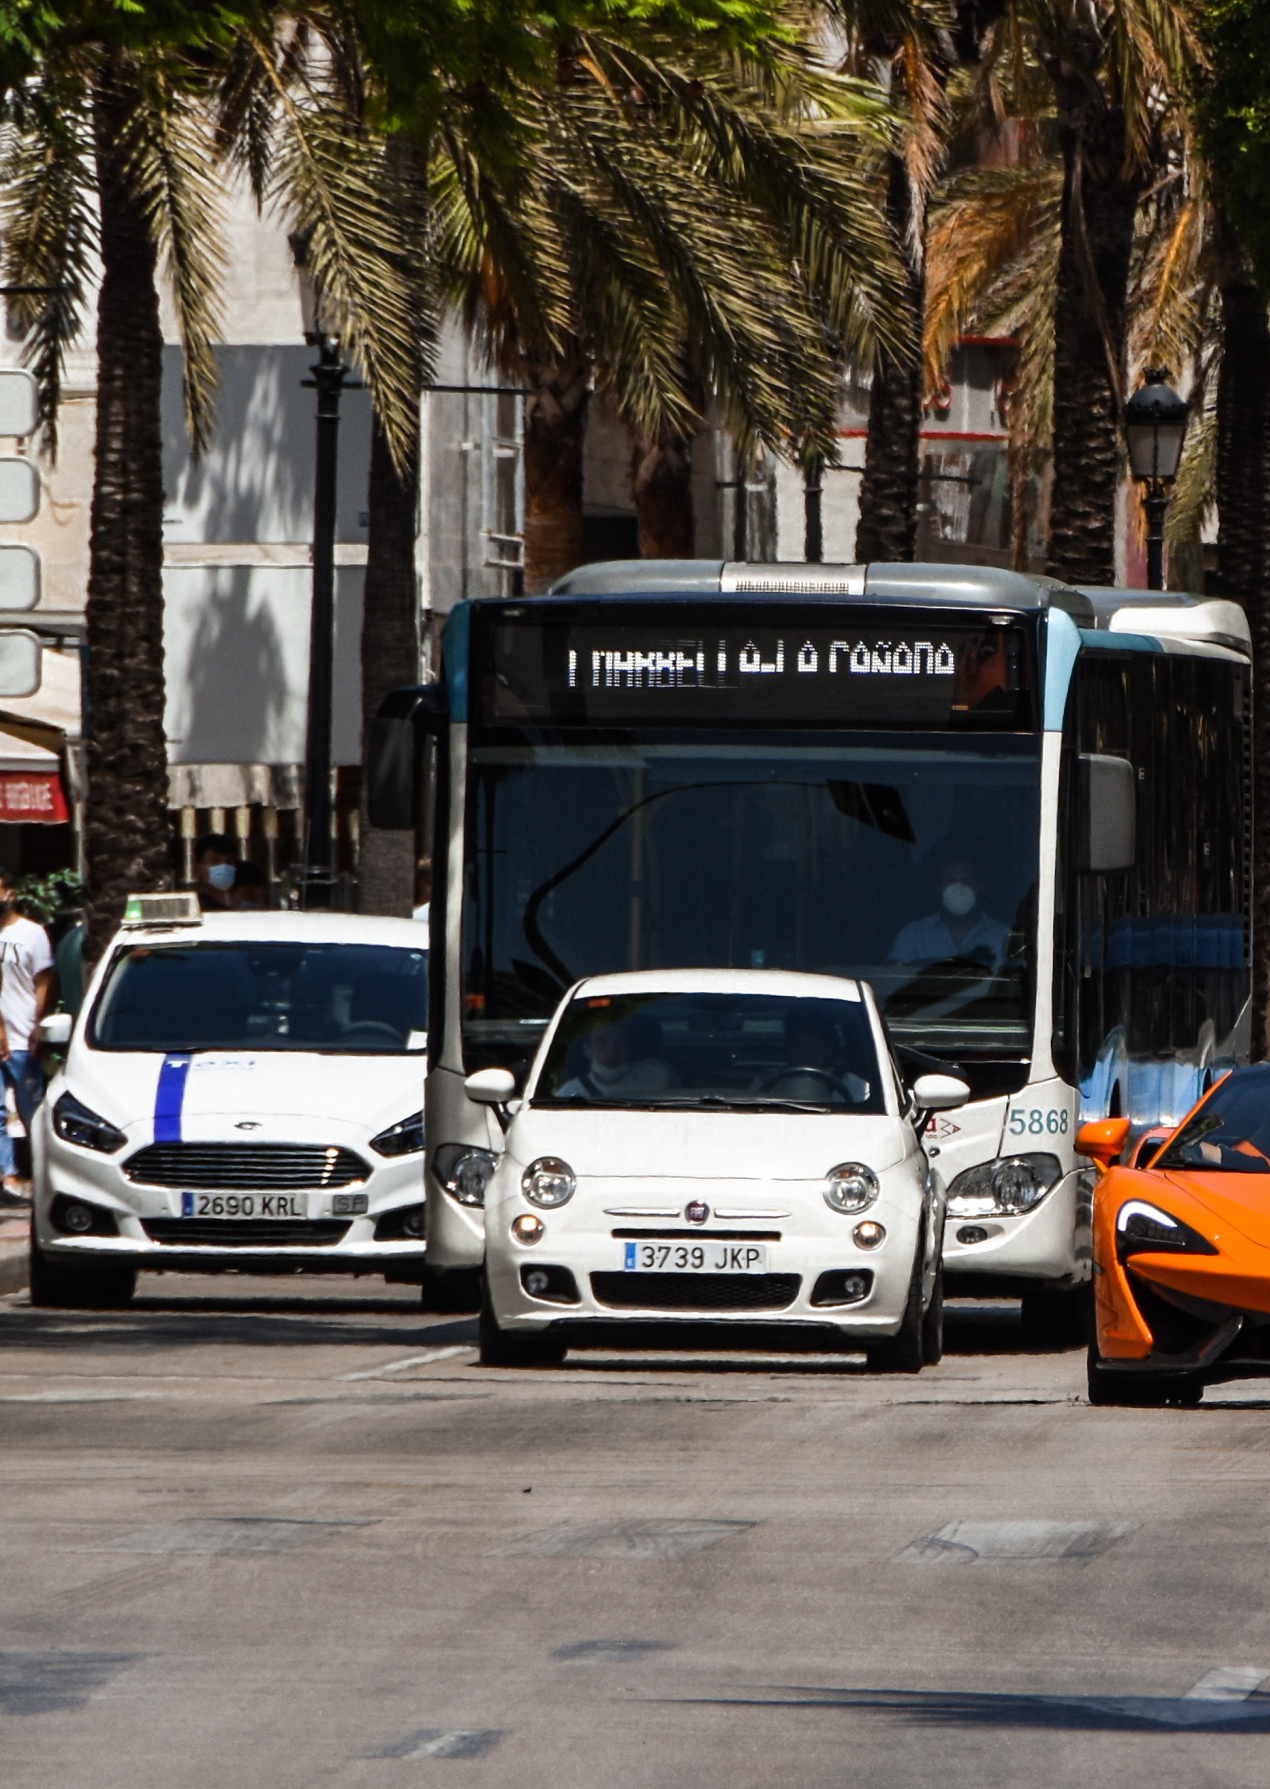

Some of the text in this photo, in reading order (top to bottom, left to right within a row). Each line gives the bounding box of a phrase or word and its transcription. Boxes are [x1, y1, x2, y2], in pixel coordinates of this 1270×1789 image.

[1008, 1108, 1069, 1136] 5868
[198, 1196, 303, 1217] 2690 KRL
[338, 1198, 364, 1212] SP
[641, 1245, 705, 1270] 3739
[715, 1247, 761, 1270] JKP
